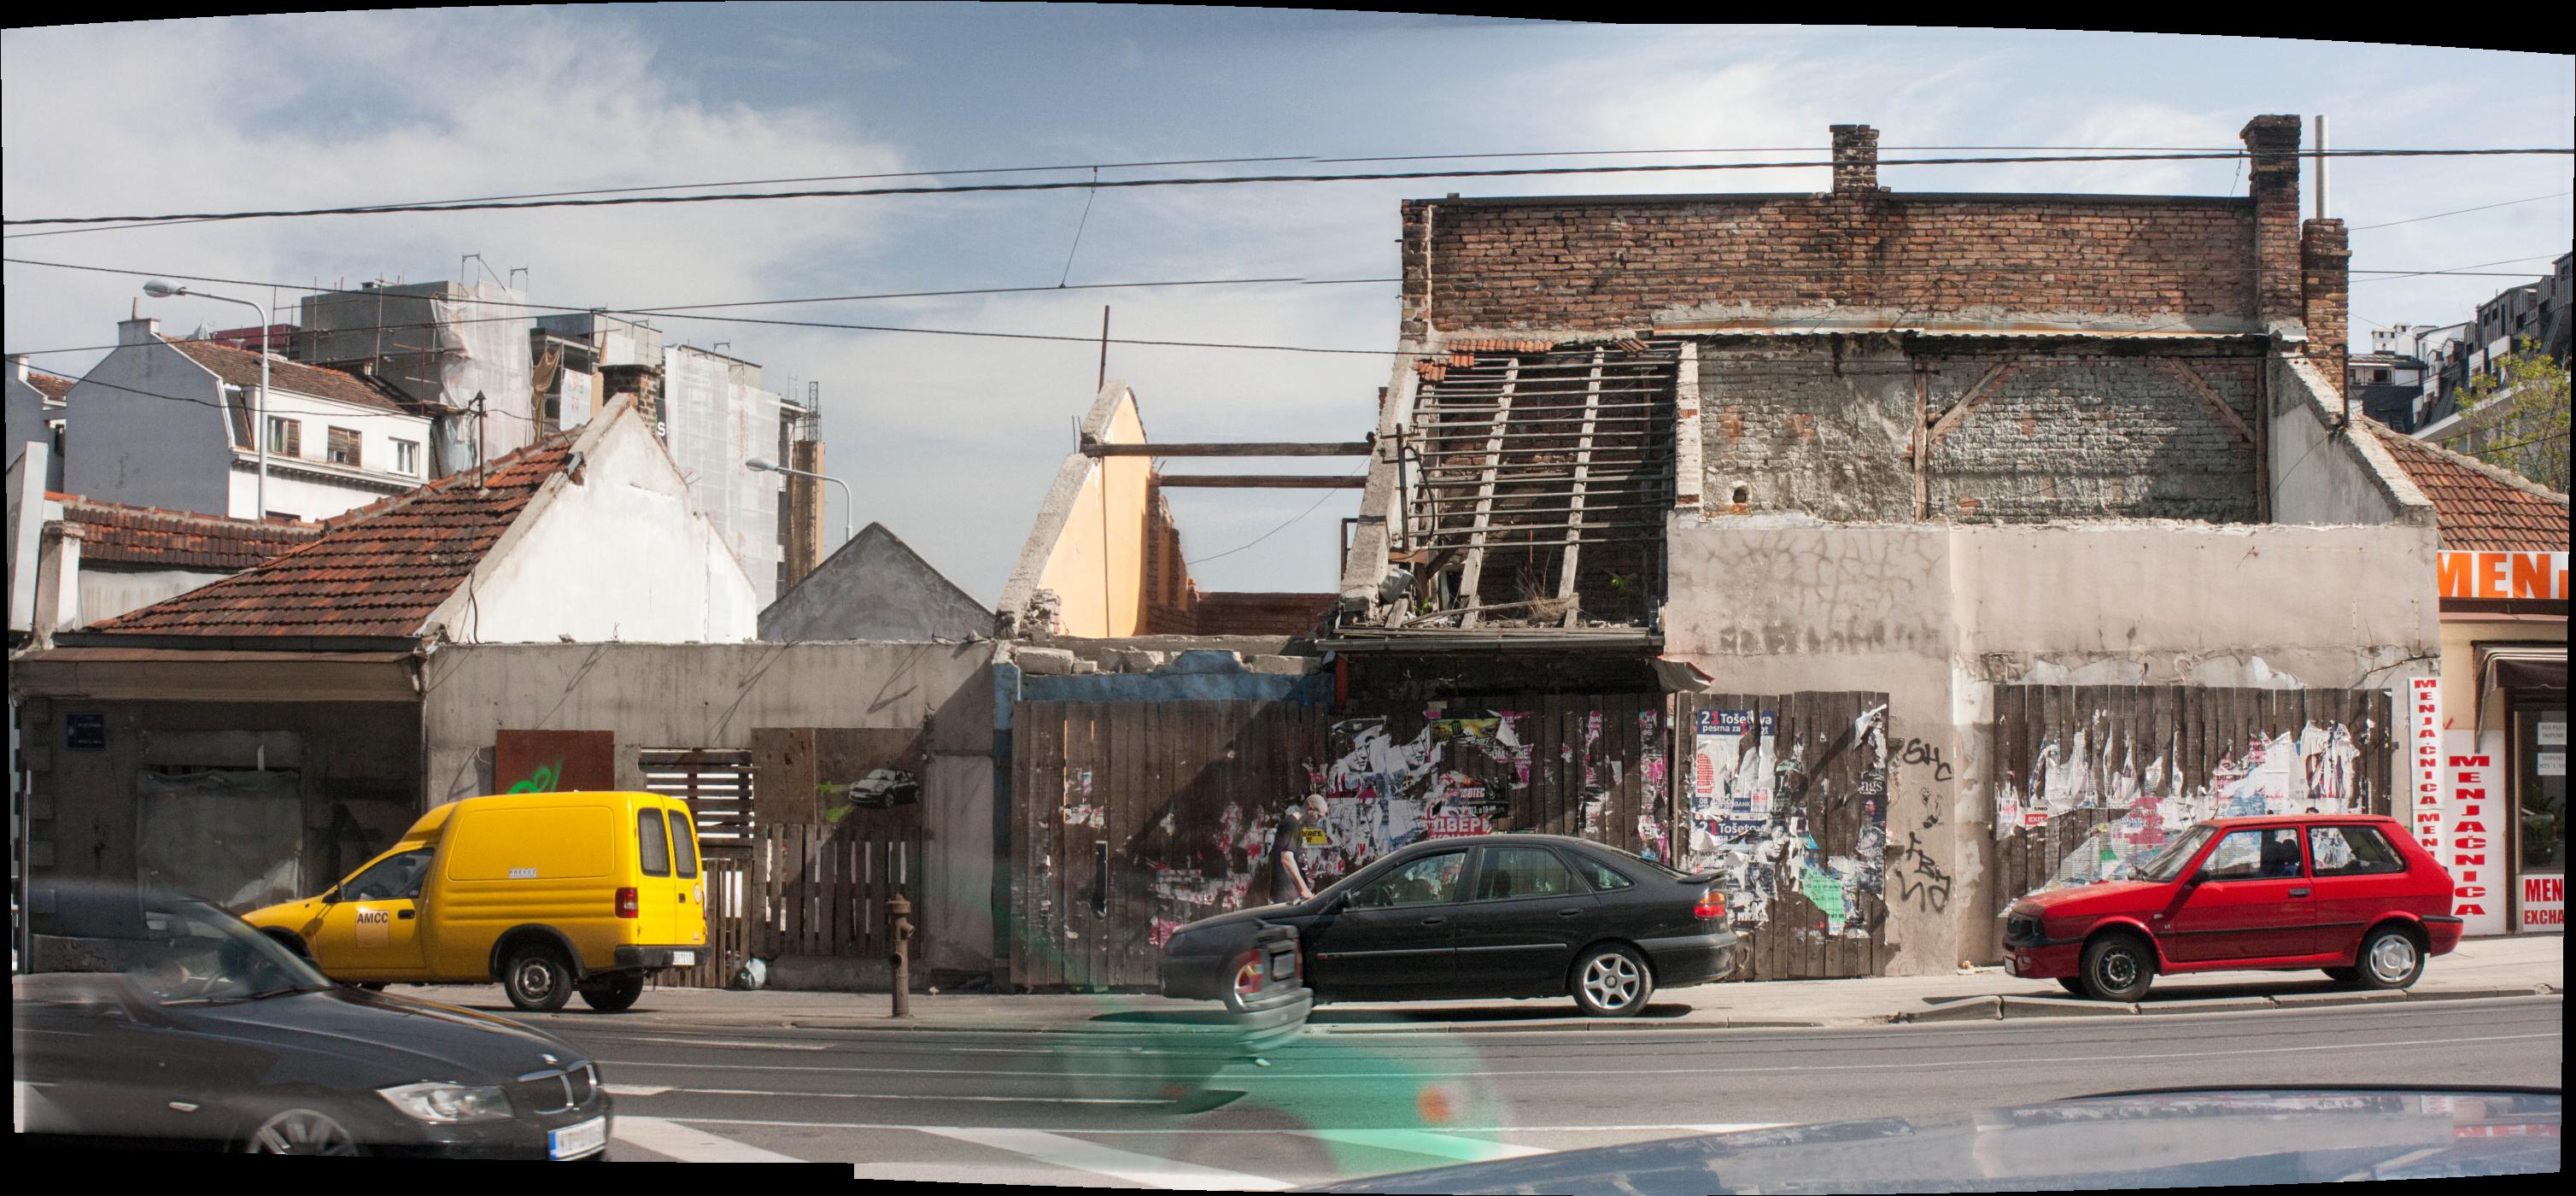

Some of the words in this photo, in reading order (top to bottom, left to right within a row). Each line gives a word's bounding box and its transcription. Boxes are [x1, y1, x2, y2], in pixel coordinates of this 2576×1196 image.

[1701, 711, 1720, 725] 21
[1702, 725, 1730, 734] pesma
[2415, 679, 2438, 806] MENJAČNICA
[2449, 755, 2491, 916] MENJAČNICA
[2525, 878, 2564, 902] MEN
[356, 912, 389, 923] AMCC
[2524, 909, 2564, 925] EXCHA
